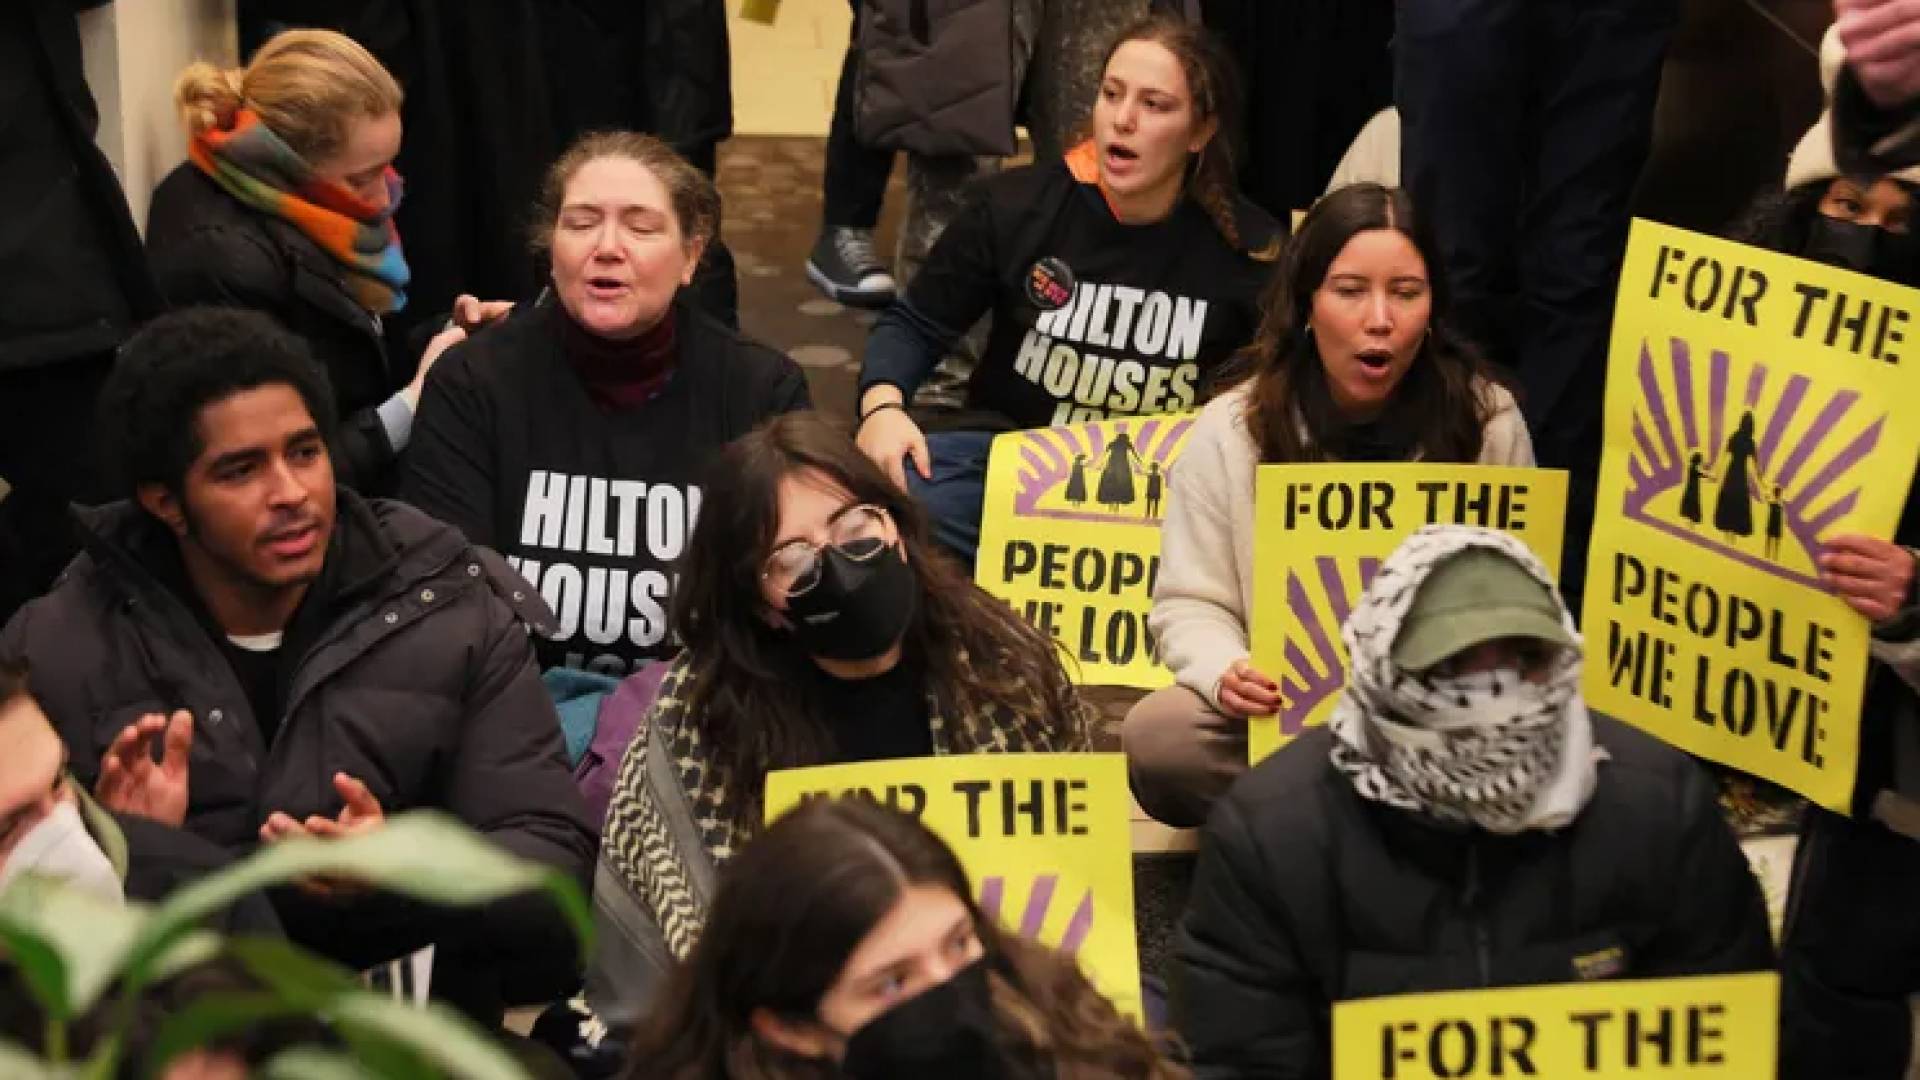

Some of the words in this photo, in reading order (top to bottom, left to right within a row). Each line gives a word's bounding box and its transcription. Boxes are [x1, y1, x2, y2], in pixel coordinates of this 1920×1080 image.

[1649, 245, 1768, 326] FOR
[1793, 281, 1911, 364] THE
[1013, 328, 1200, 414] HOUSES
[1284, 481, 1396, 530] FOR
[1416, 481, 1529, 530] THE
[506, 554, 684, 647] OUS
[1613, 552, 1836, 683] PEOPLE
[1608, 619, 1676, 718] WE
[1694, 655, 1829, 768] LOVE
[953, 779, 1088, 837] THE
[1381, 1016, 1538, 1080] FOR
[1569, 1003, 1726, 1071] THE
